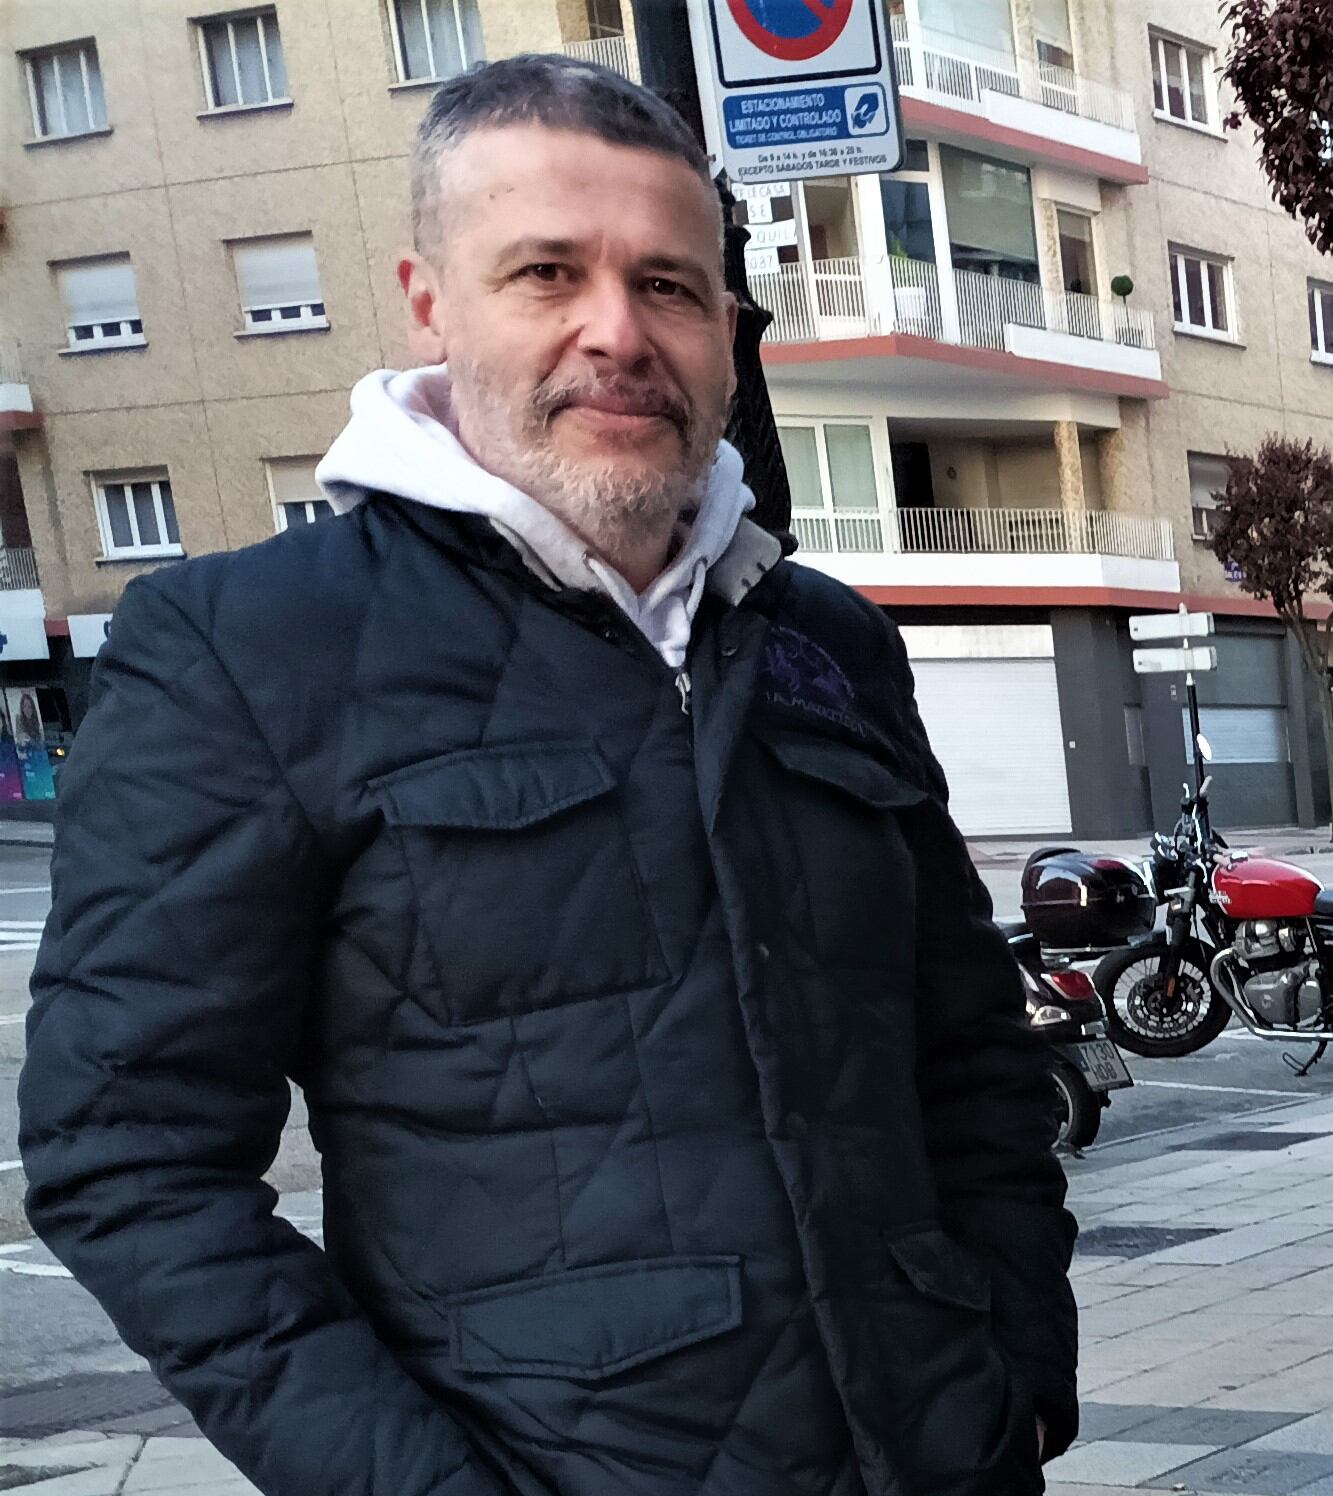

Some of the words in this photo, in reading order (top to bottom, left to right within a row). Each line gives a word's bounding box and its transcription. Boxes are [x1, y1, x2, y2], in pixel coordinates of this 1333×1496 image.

[741, 93, 825, 114] ESTACIONAMIENTO
[729, 116, 771, 133] LIMITADO
[779, 108, 842, 128] CONTROLADO
[738, 164, 774, 177] EXCEPTO
[848, 154, 887, 167] FESTIVOS
